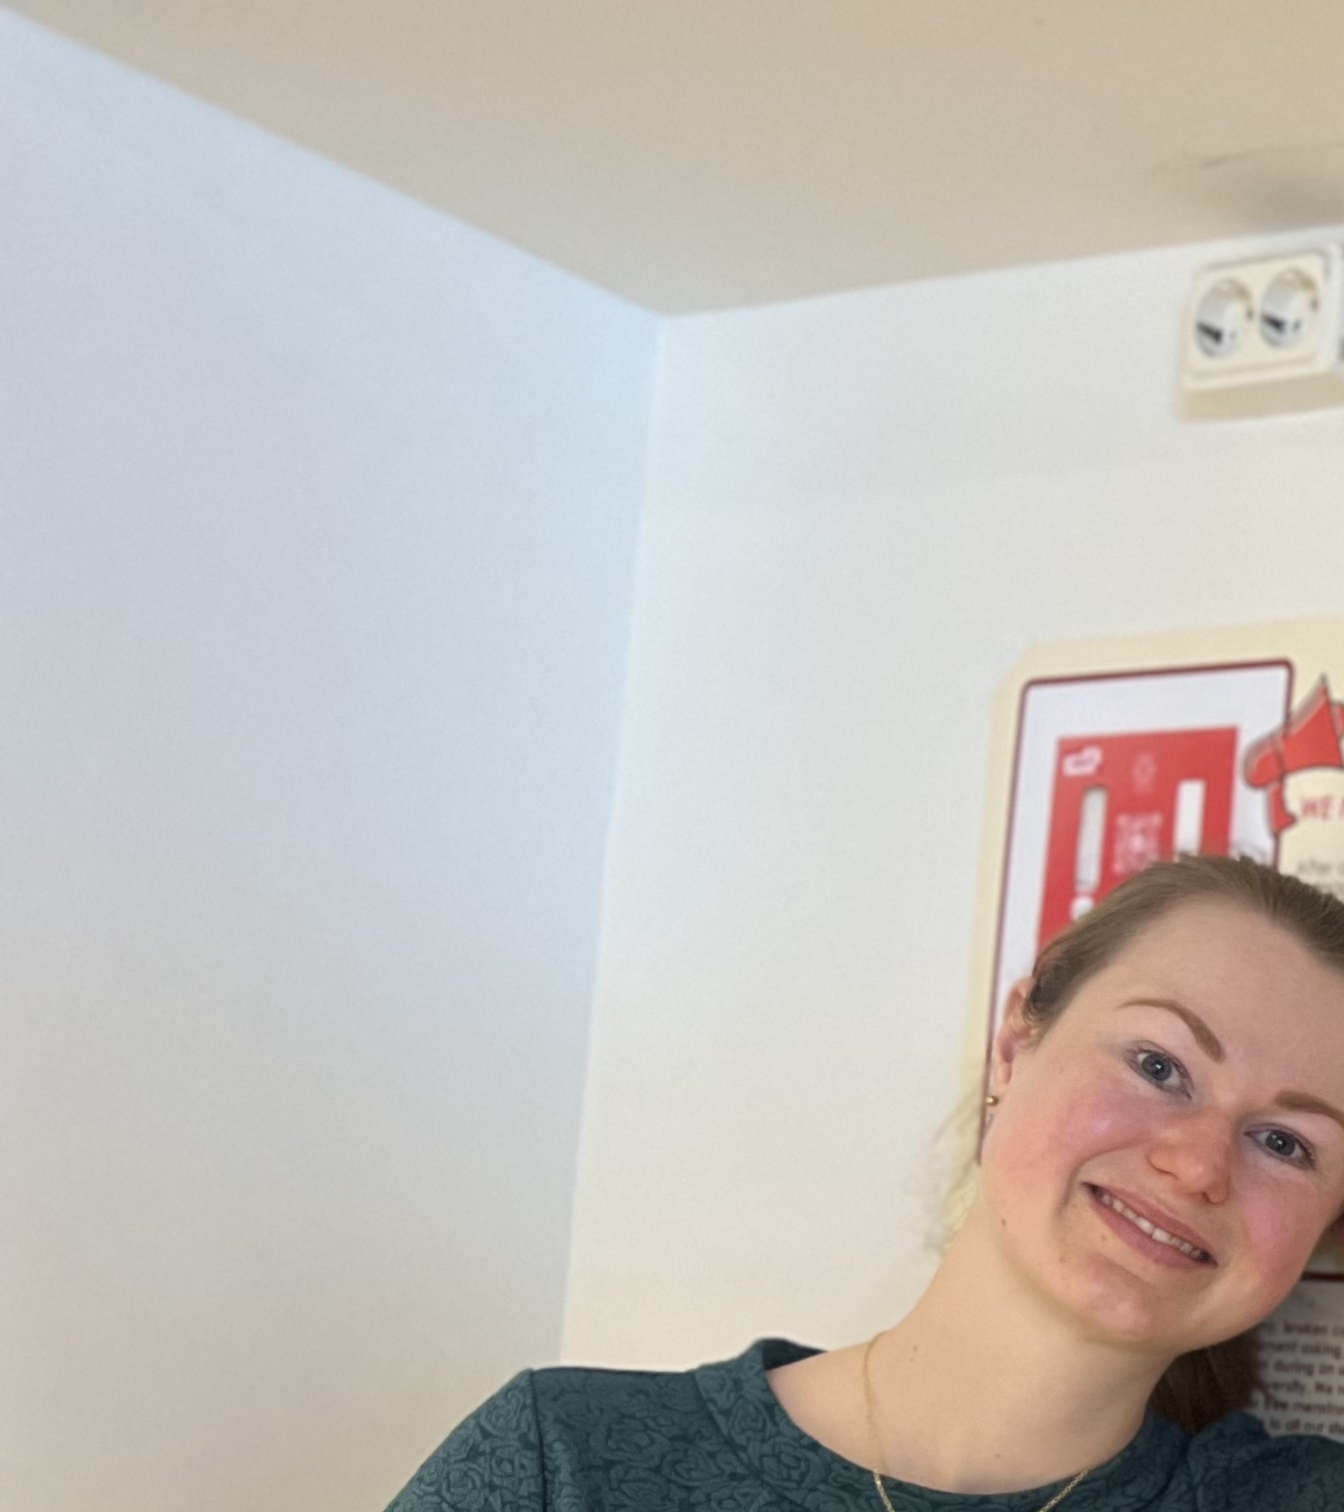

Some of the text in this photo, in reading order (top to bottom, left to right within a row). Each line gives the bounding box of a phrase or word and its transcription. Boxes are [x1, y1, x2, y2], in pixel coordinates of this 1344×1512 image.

[1299, 795, 1335, 820] WE
[1273, 1360, 1315, 1377] during
[1318, 1364, 1335, 1376] an
[1304, 1421, 1326, 1433] our
